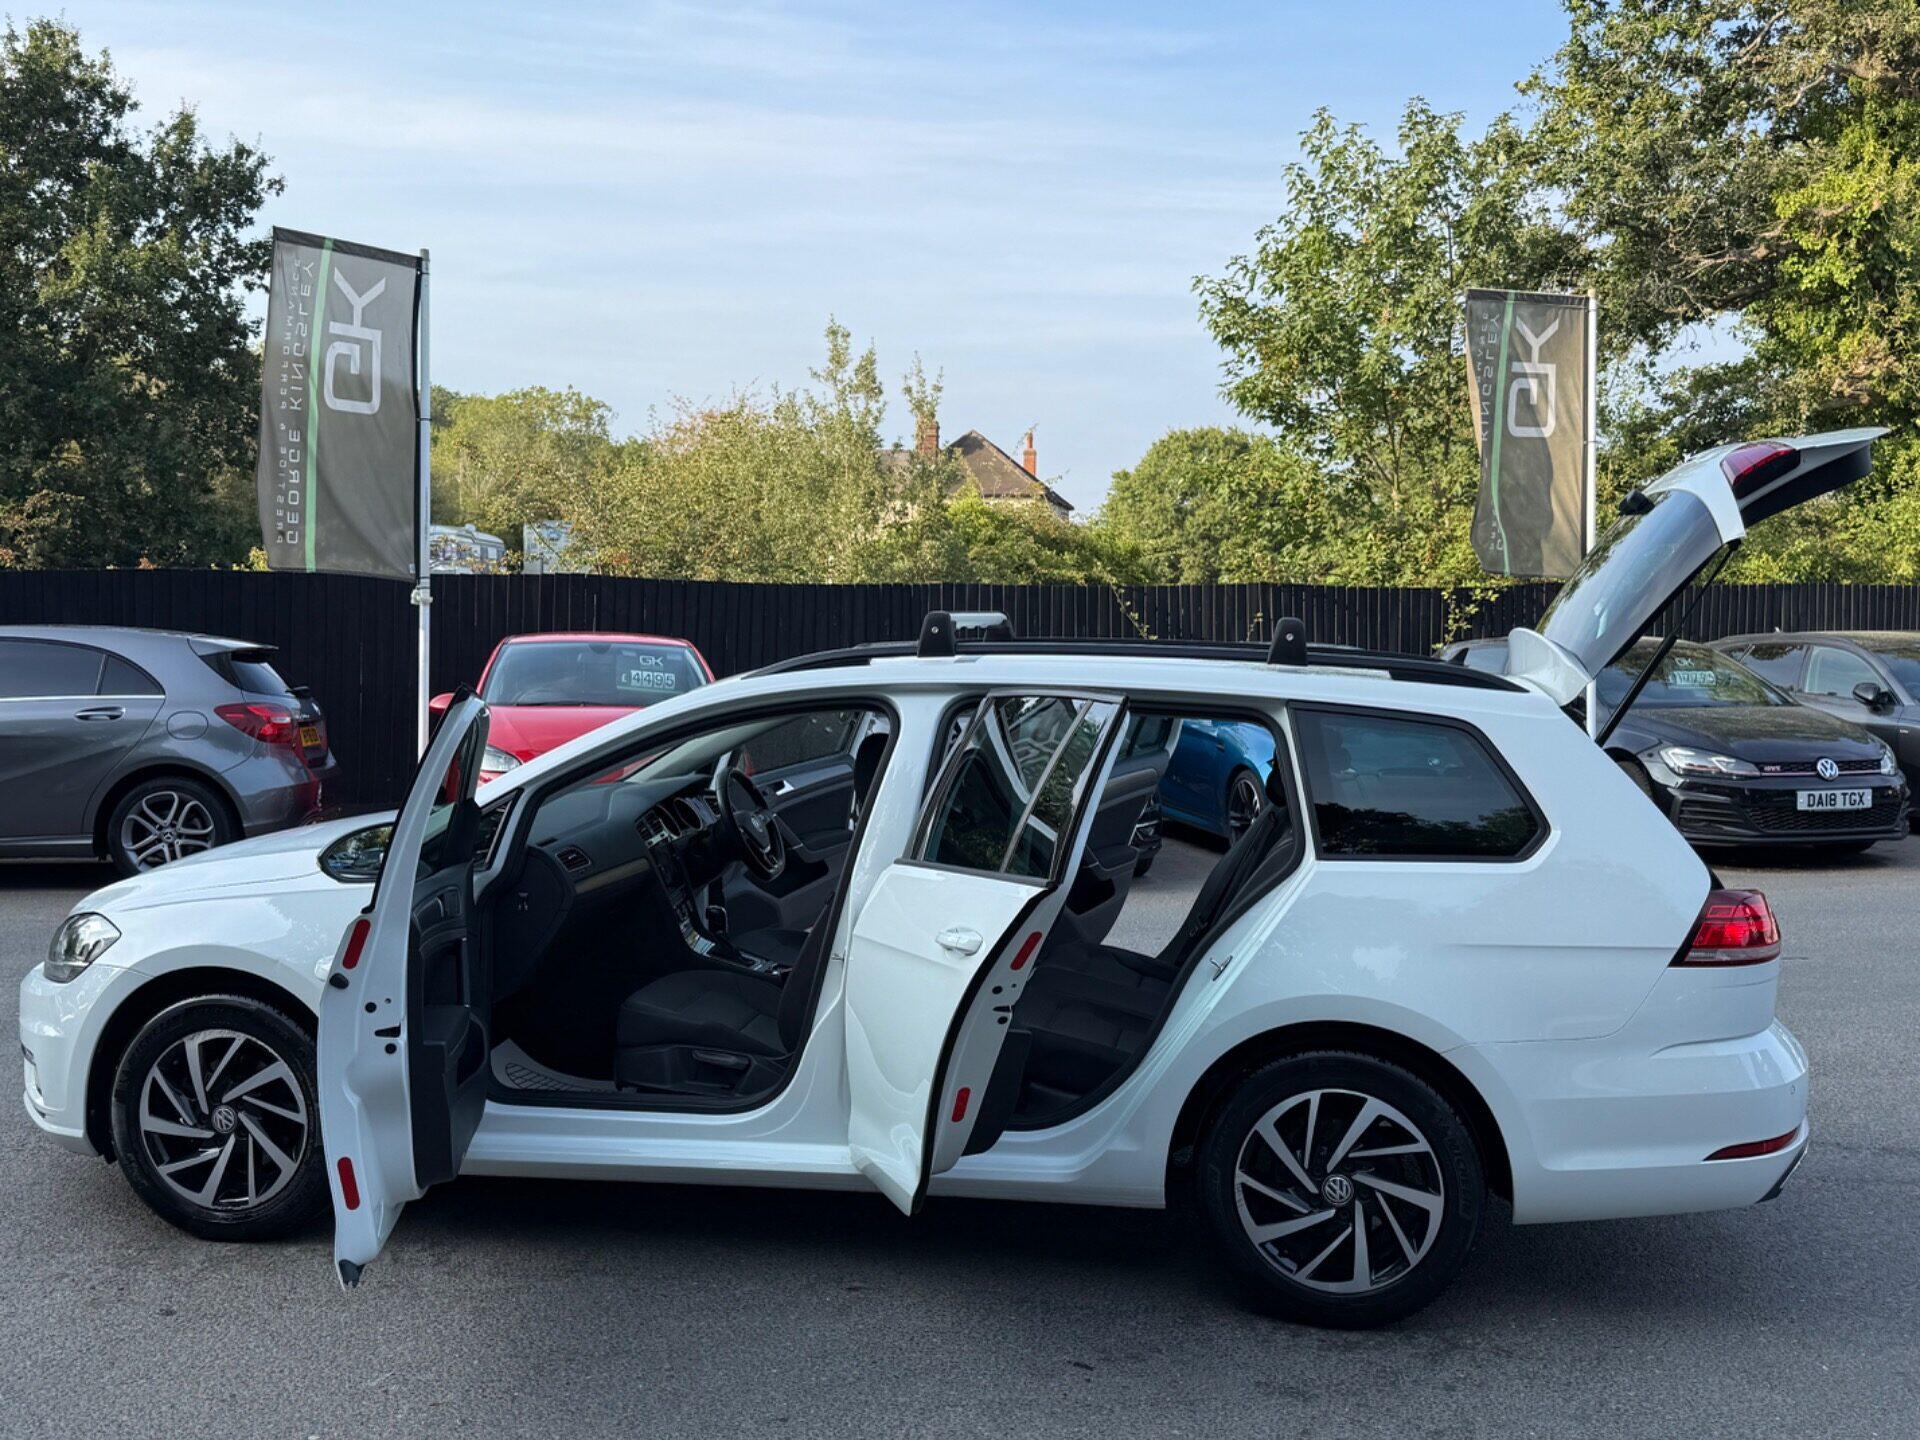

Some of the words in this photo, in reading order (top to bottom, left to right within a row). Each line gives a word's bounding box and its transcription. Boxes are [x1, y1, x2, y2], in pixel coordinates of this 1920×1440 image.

[639, 655, 664, 666] GK
[1807, 793, 1837, 807] DA18
[1841, 792, 1865, 806] TGX
